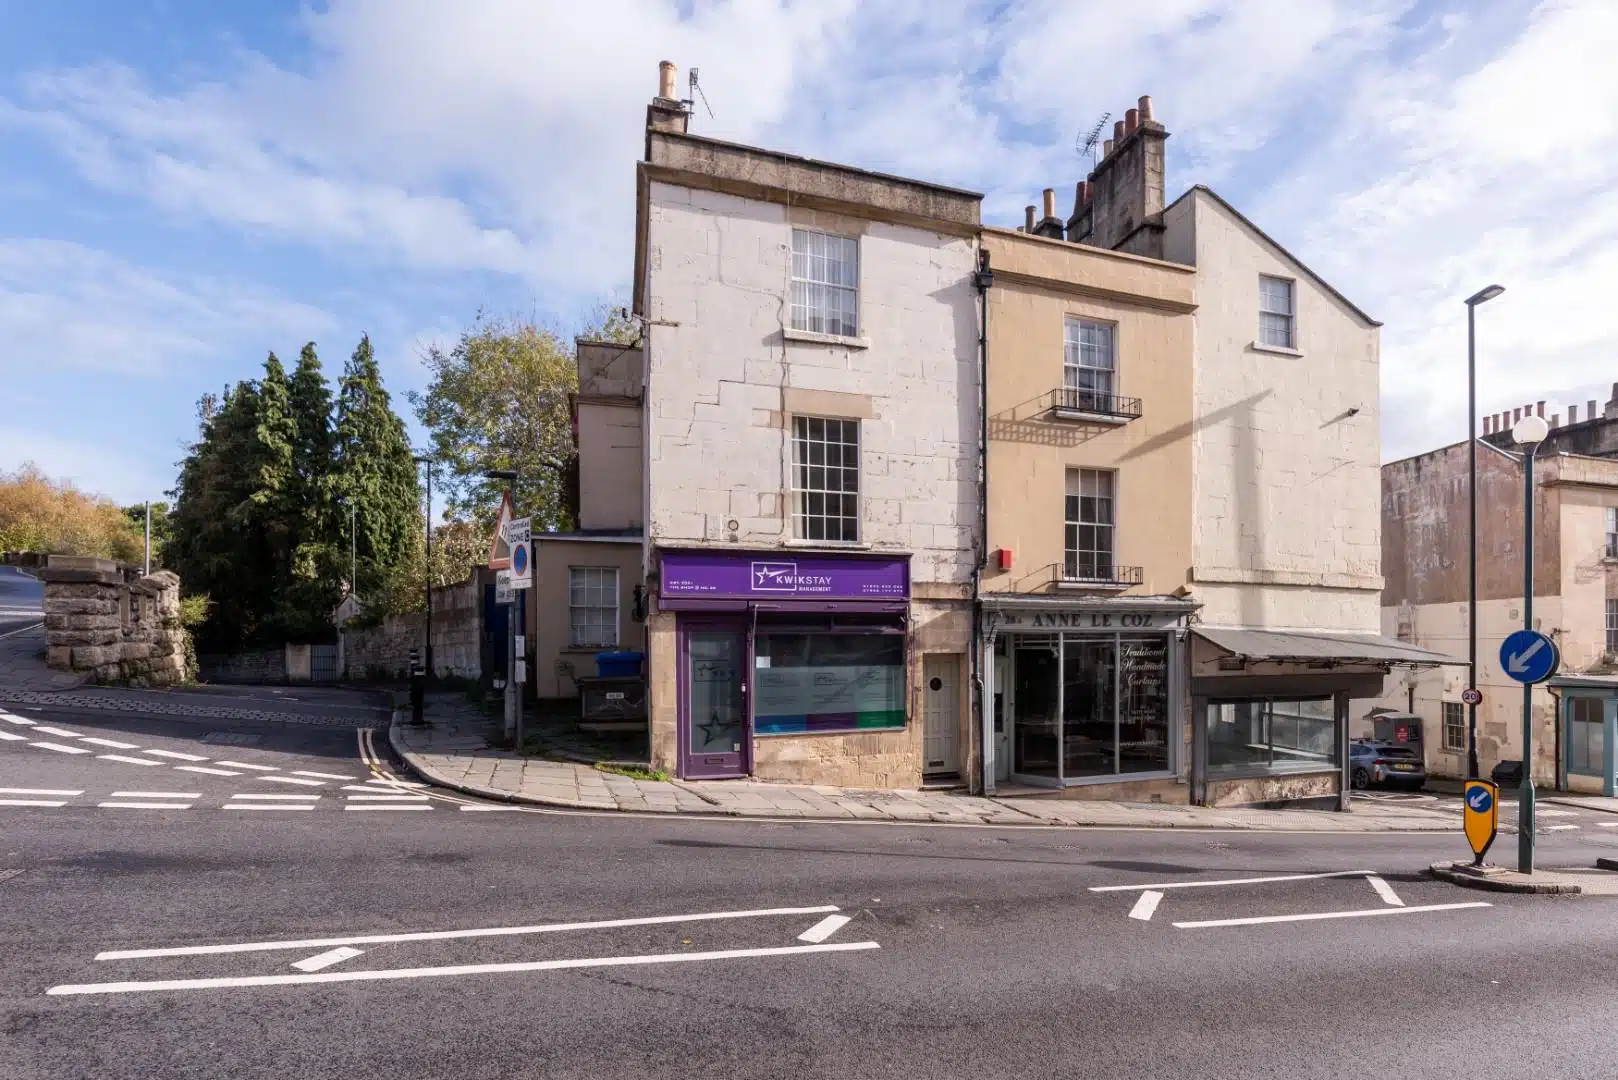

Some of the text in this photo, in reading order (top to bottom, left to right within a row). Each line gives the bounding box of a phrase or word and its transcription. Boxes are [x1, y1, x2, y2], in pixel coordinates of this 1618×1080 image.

[511, 533, 524, 543] ZONE
[776, 575, 832, 585] KWIKSTAY
[1031, 612, 1081, 628] ANNE
[1091, 613, 1112, 628] LE
[1120, 613, 1153, 628] COZ
[1120, 645, 1166, 657] Traditional
[1120, 659, 1167, 671] Handmade
[1127, 672, 1162, 686] Curtains
[1464, 692, 1476, 700] 20
